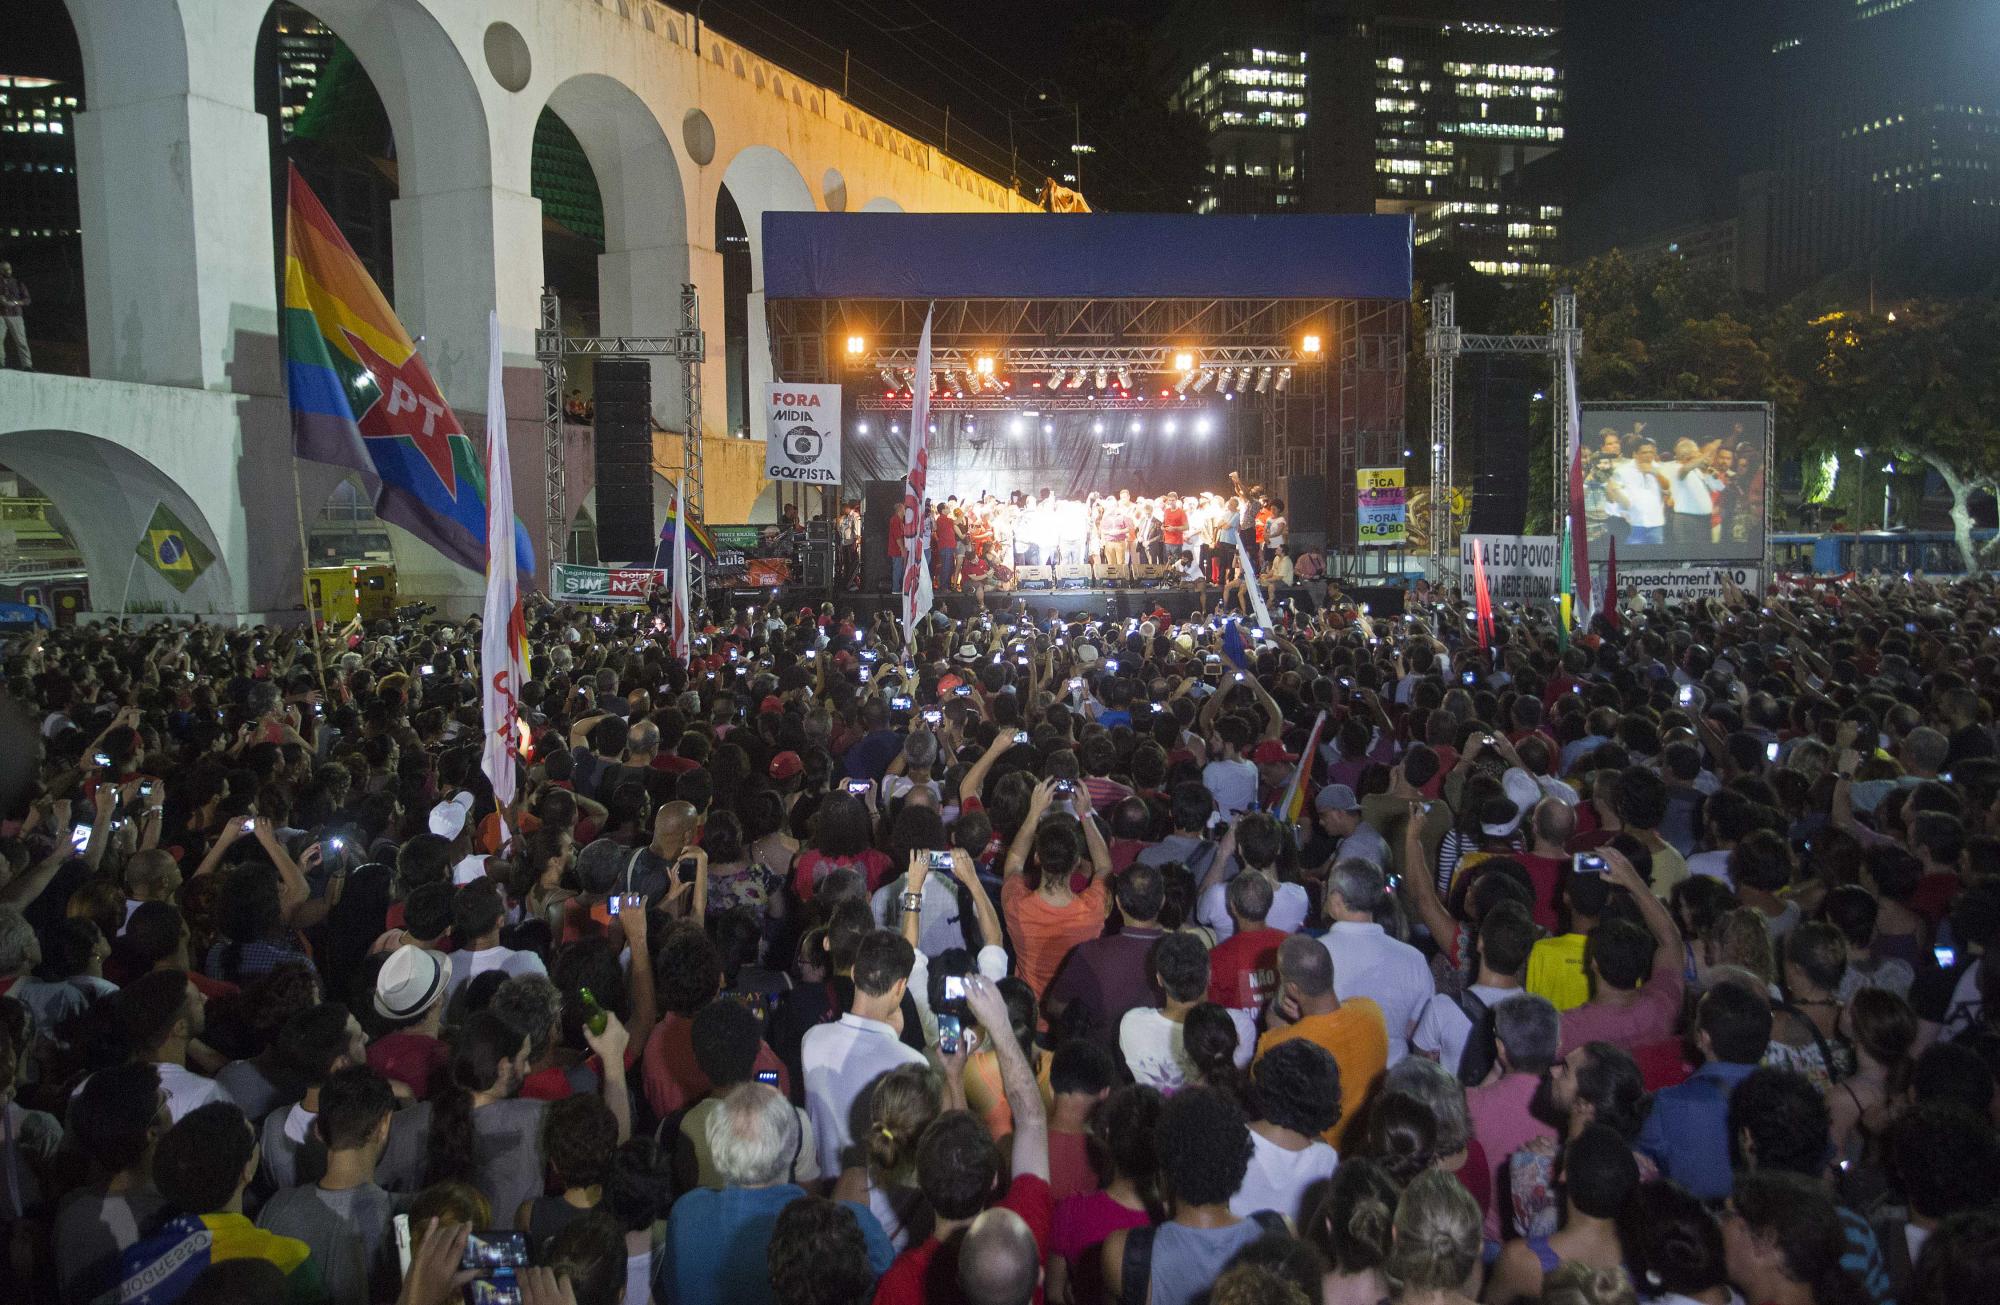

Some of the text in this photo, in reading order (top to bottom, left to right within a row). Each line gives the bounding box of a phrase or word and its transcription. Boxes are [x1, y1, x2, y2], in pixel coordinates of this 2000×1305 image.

[386, 376, 445, 437] PT
[772, 392, 821, 407] FORA
[769, 465, 836, 481] GOLPISTA
[1367, 478, 1395, 488] FICA
[1368, 513, 1398, 523] FORA
[718, 554, 745, 566] Lula
[1463, 539, 1554, 568] LUA É DO POVO!
[566, 578, 601, 592] SIM
[1462, 573, 1493, 597] ABO
[1502, 574, 1521, 598] REDE
